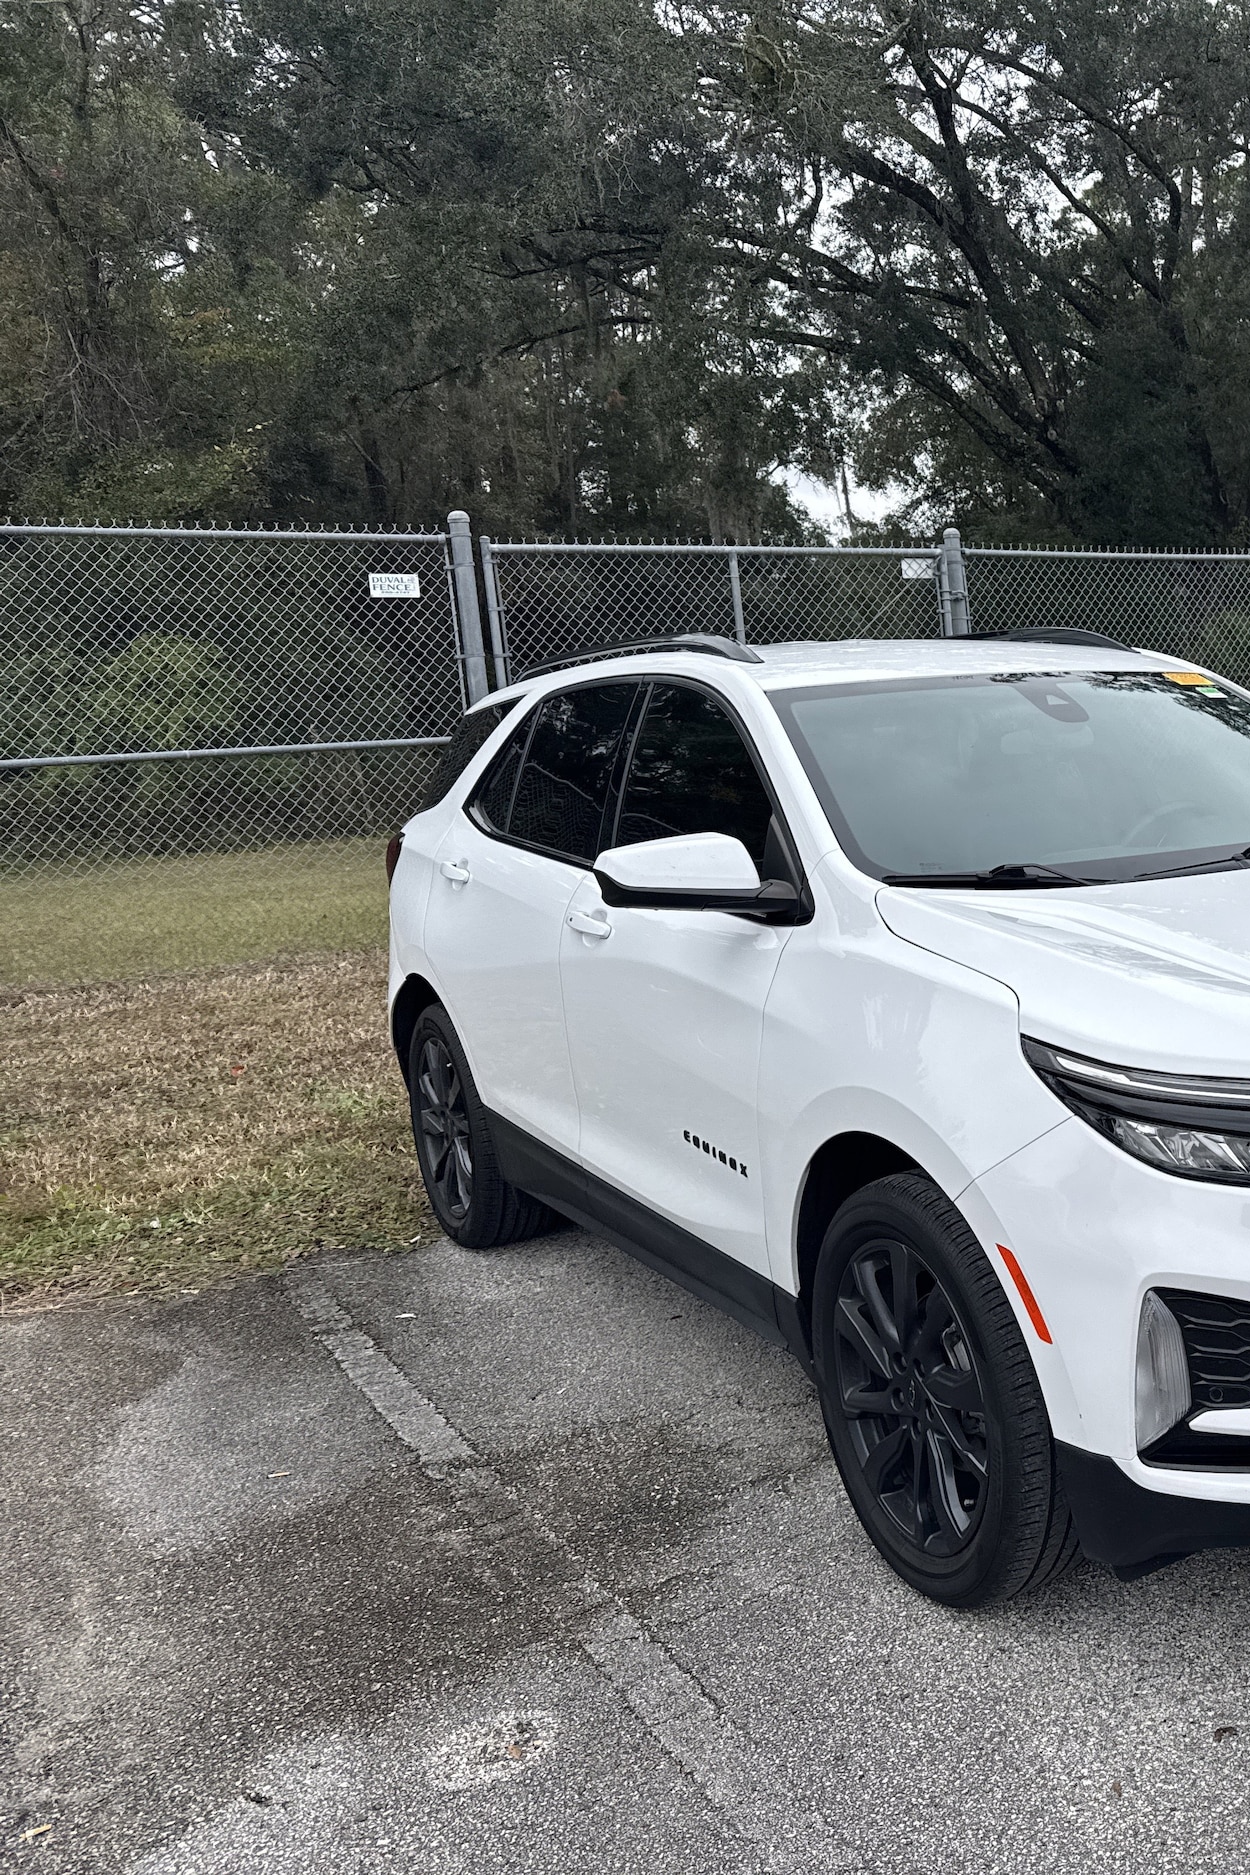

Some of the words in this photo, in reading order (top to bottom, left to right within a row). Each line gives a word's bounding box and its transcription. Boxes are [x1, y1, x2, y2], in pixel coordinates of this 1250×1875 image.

[371, 576, 406, 584] DUVAL
[372, 583, 411, 591] FENCE
[683, 1129, 748, 1178] EQUINOX
